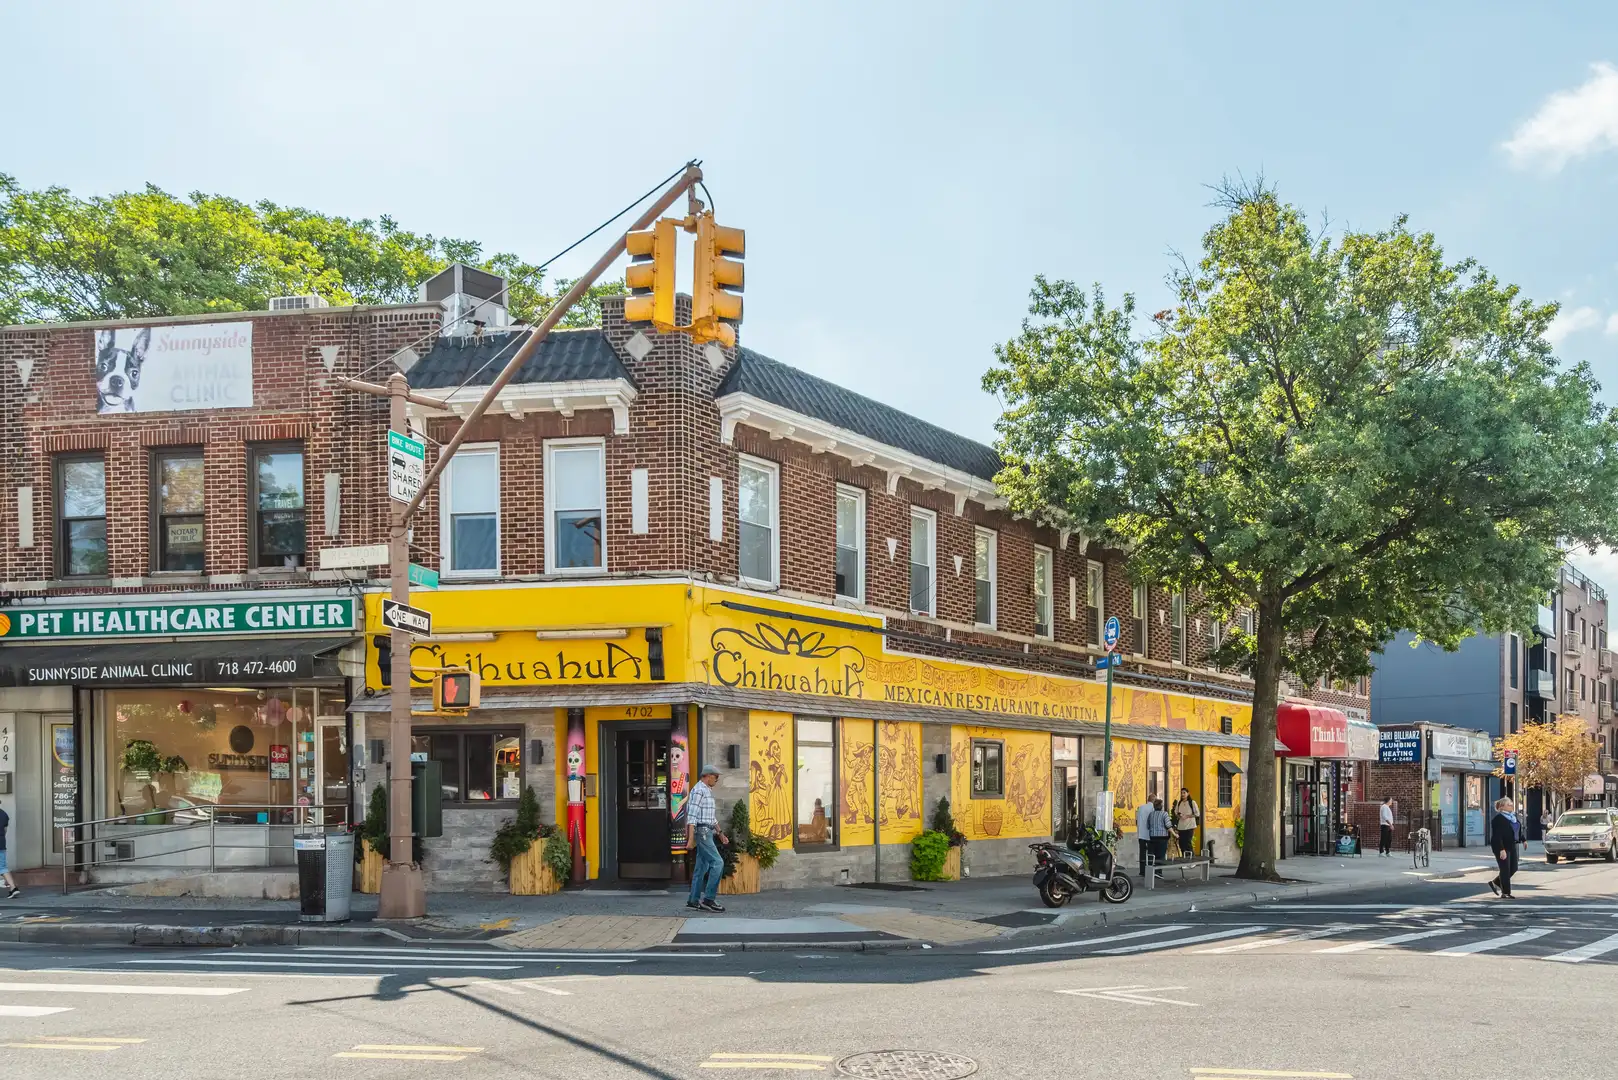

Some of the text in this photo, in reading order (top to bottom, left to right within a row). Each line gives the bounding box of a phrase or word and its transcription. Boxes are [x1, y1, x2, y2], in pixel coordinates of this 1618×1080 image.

[157, 327, 248, 356] Sunnyside
[171, 362, 244, 381] ANIMAL
[170, 383, 237, 404] CLINIC
[391, 435, 422, 456] BIKE ROUTE
[392, 469, 422, 489] SHARED
[274, 499, 294, 508] TRAVEL
[170, 527, 198, 536] NOTARY
[20, 603, 345, 634] PET HEALTHCARE CENTER
[391, 609, 427, 629] ONE WAY
[29, 660, 297, 681] SUNNYSIDE ANIMAL CLINIC 718 472-4600
[884, 684, 1099, 721] MEXICAN RESTAURANT & CANTINA
[1312, 726, 1335, 742] Think
[1380, 731, 1393, 740] ENRI
[271, 751, 288, 760] Open
